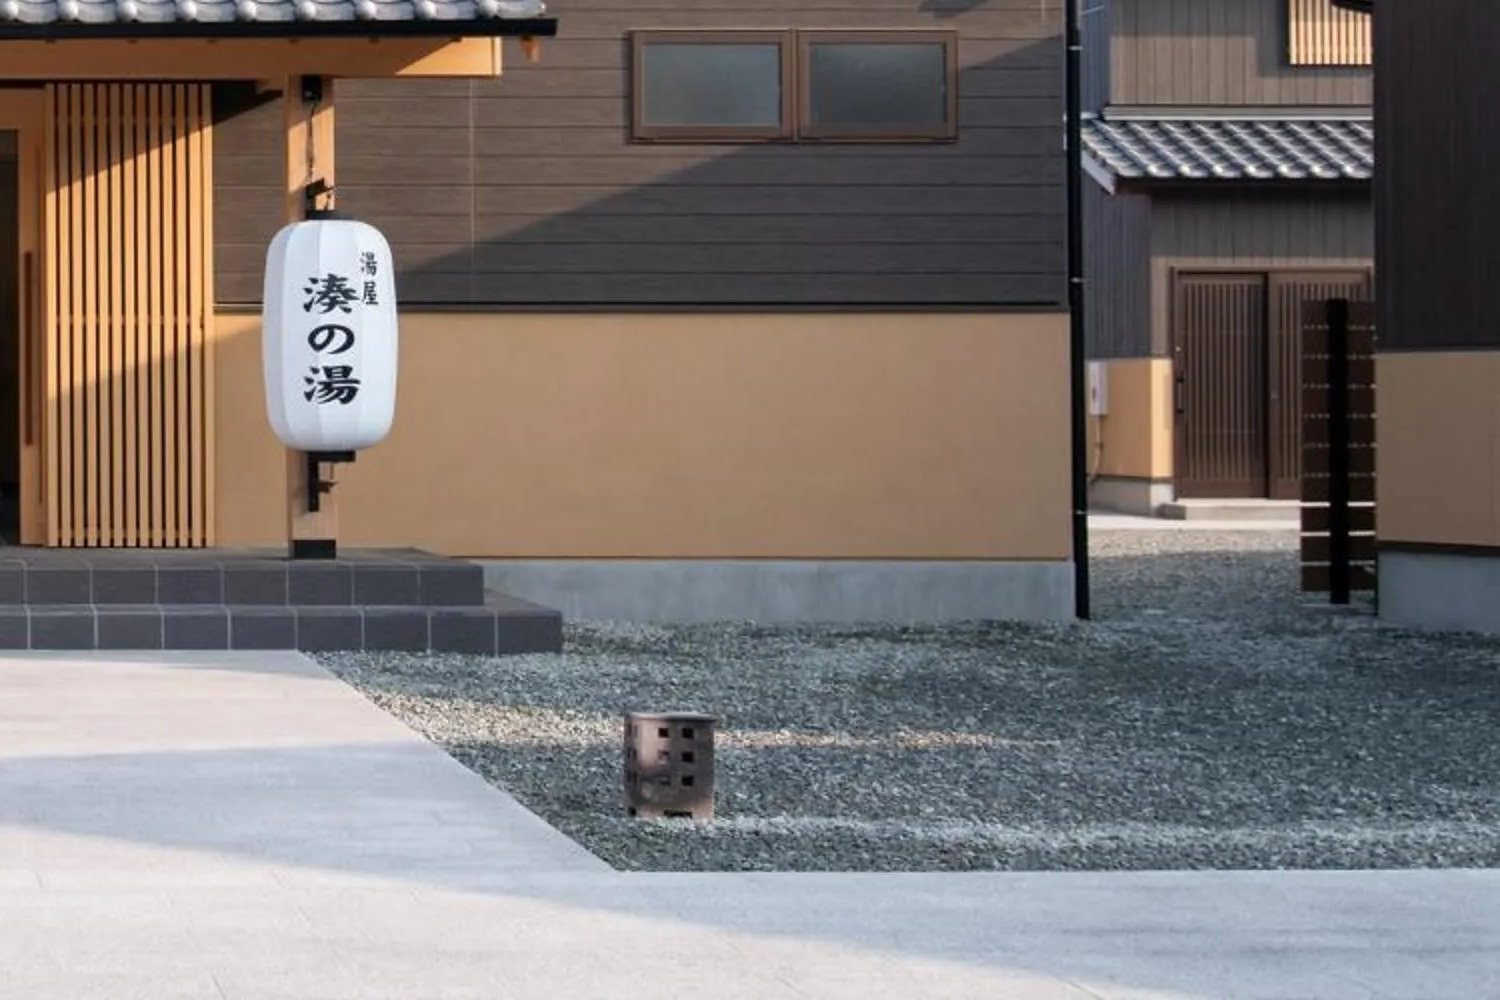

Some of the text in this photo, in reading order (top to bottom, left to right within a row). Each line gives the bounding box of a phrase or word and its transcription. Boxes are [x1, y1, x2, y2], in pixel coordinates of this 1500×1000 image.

[360, 251, 379, 306] 湯屋
[303, 273, 361, 405] 湊の湯
